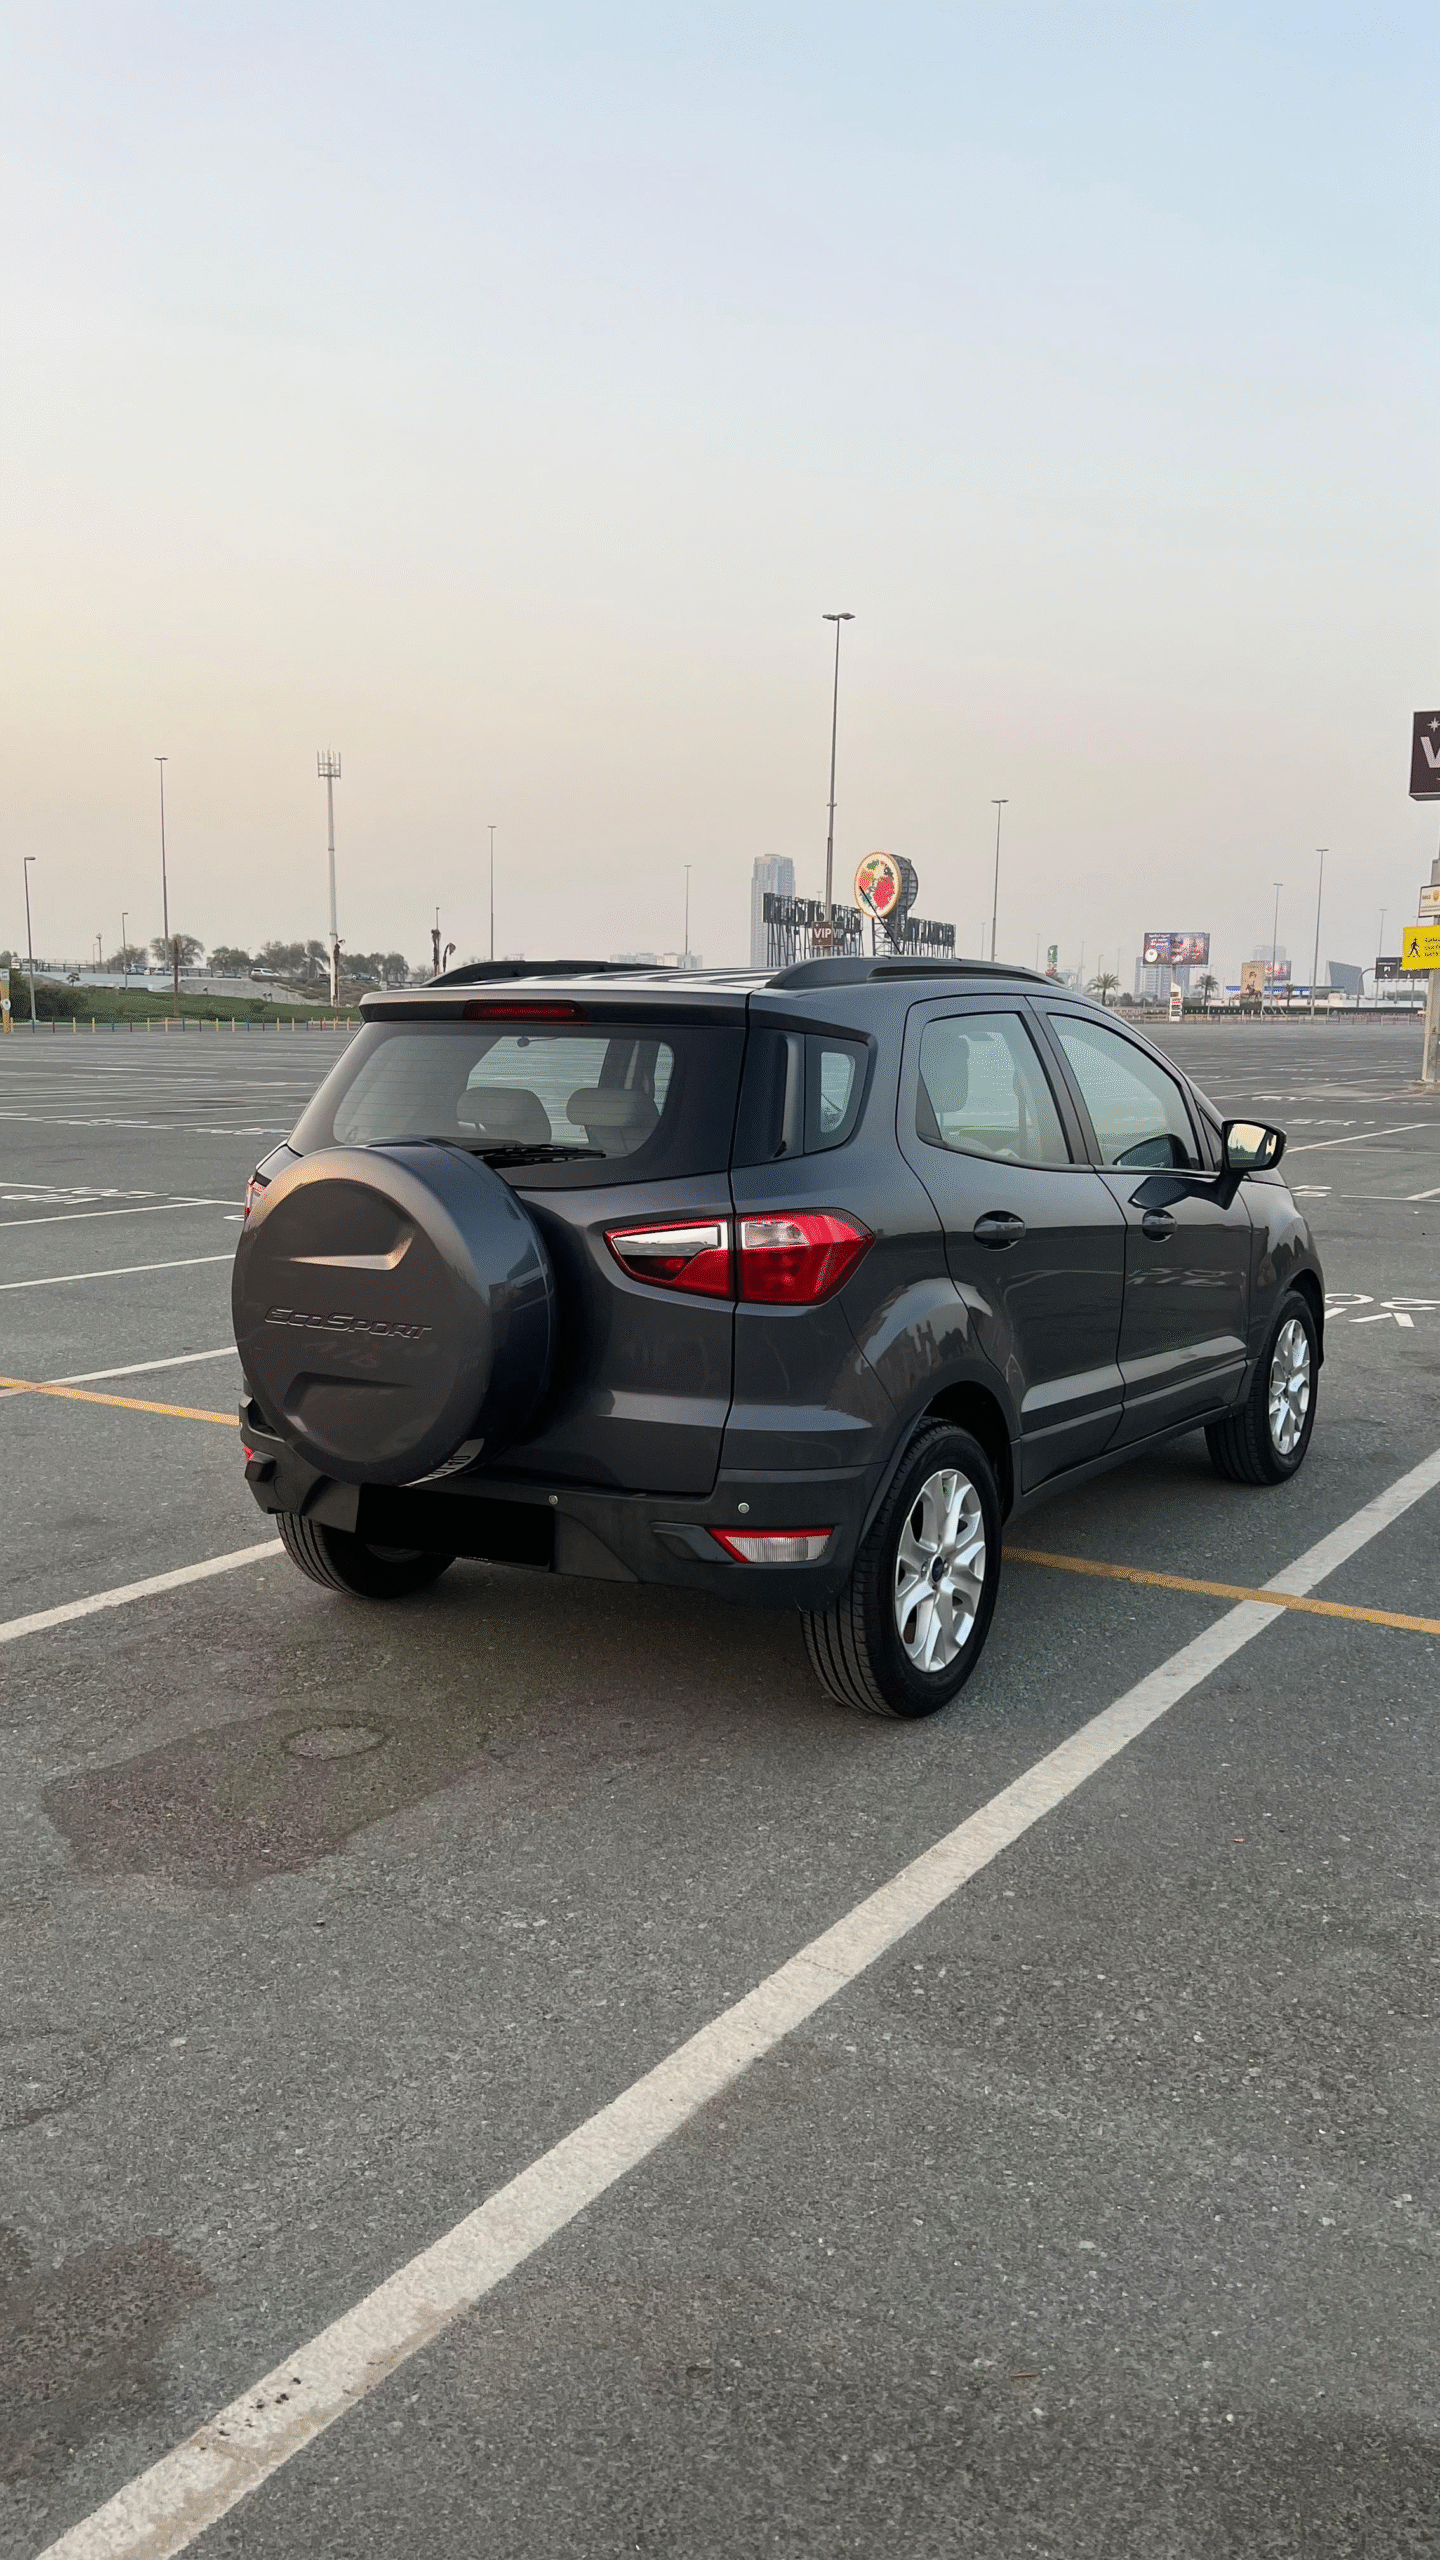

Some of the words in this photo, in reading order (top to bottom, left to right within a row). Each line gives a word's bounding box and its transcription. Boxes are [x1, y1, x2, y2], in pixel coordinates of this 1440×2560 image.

[813, 927, 832, 939] VIP
[833, 928, 845, 939] VIP
[1, 1193, 101, 1205] VIP
